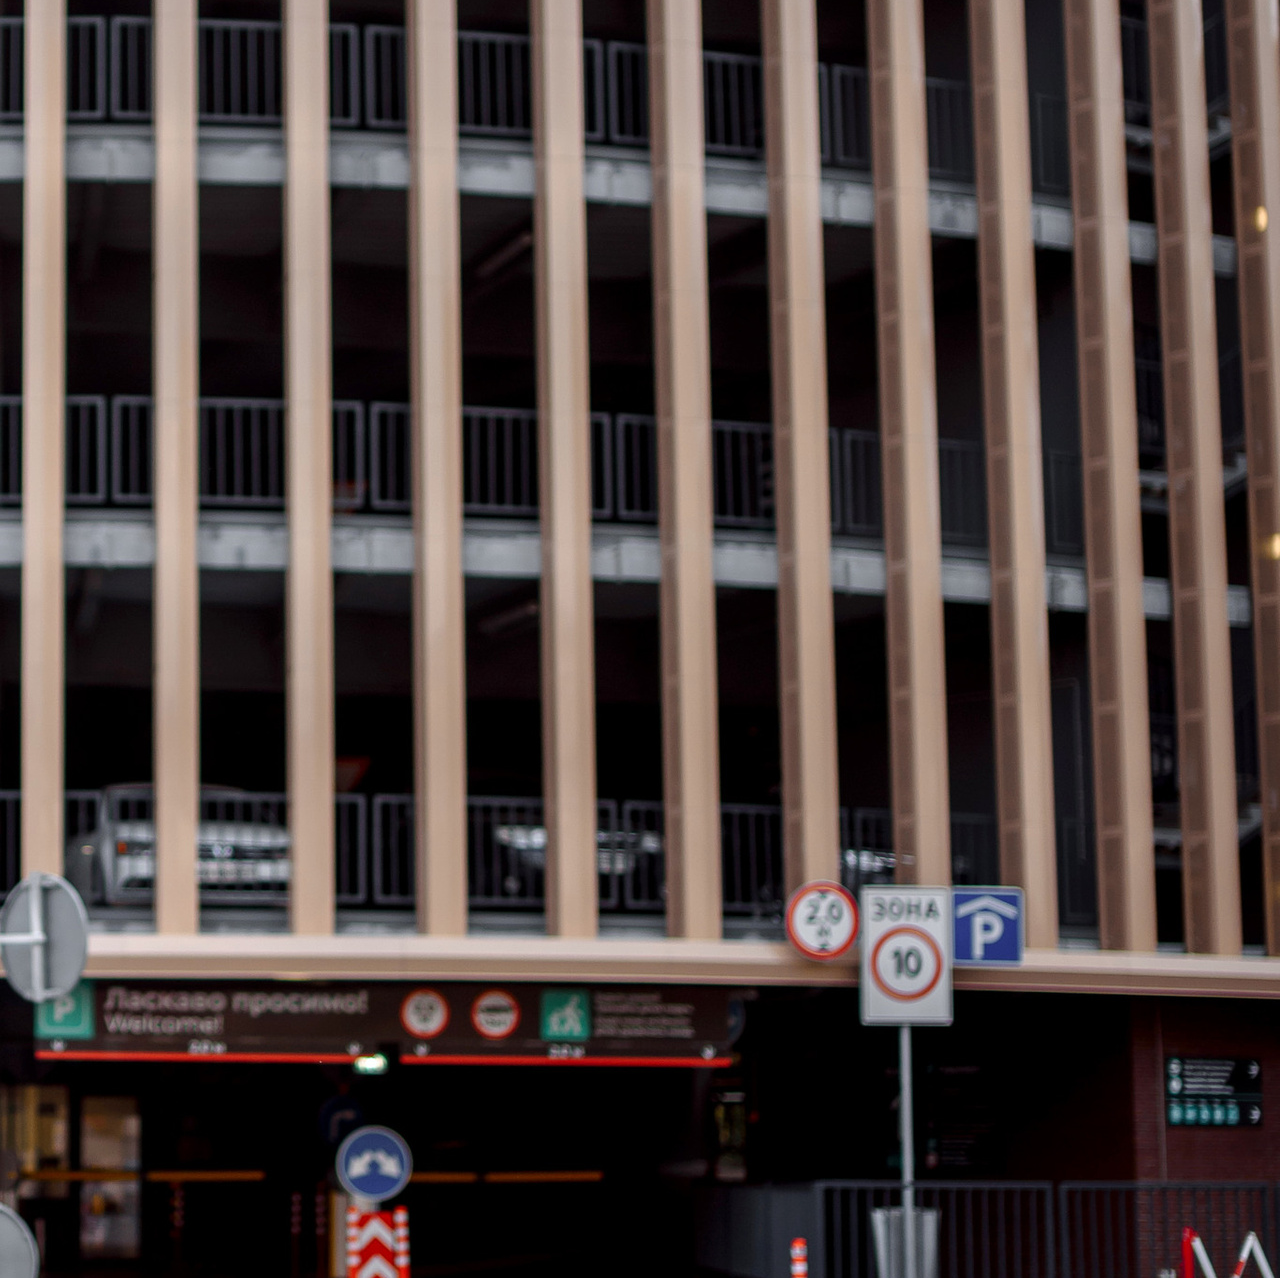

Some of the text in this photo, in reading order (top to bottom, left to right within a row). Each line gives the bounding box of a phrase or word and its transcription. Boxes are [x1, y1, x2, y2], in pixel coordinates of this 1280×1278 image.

[872, 897, 941, 921] ЗОНА
[972, 912, 1004, 960] P
[892, 947, 922, 977] 10
[105, 987, 368, 1017] Ласкаво просимо!
[105, 1014, 224, 1035] Welcome!
